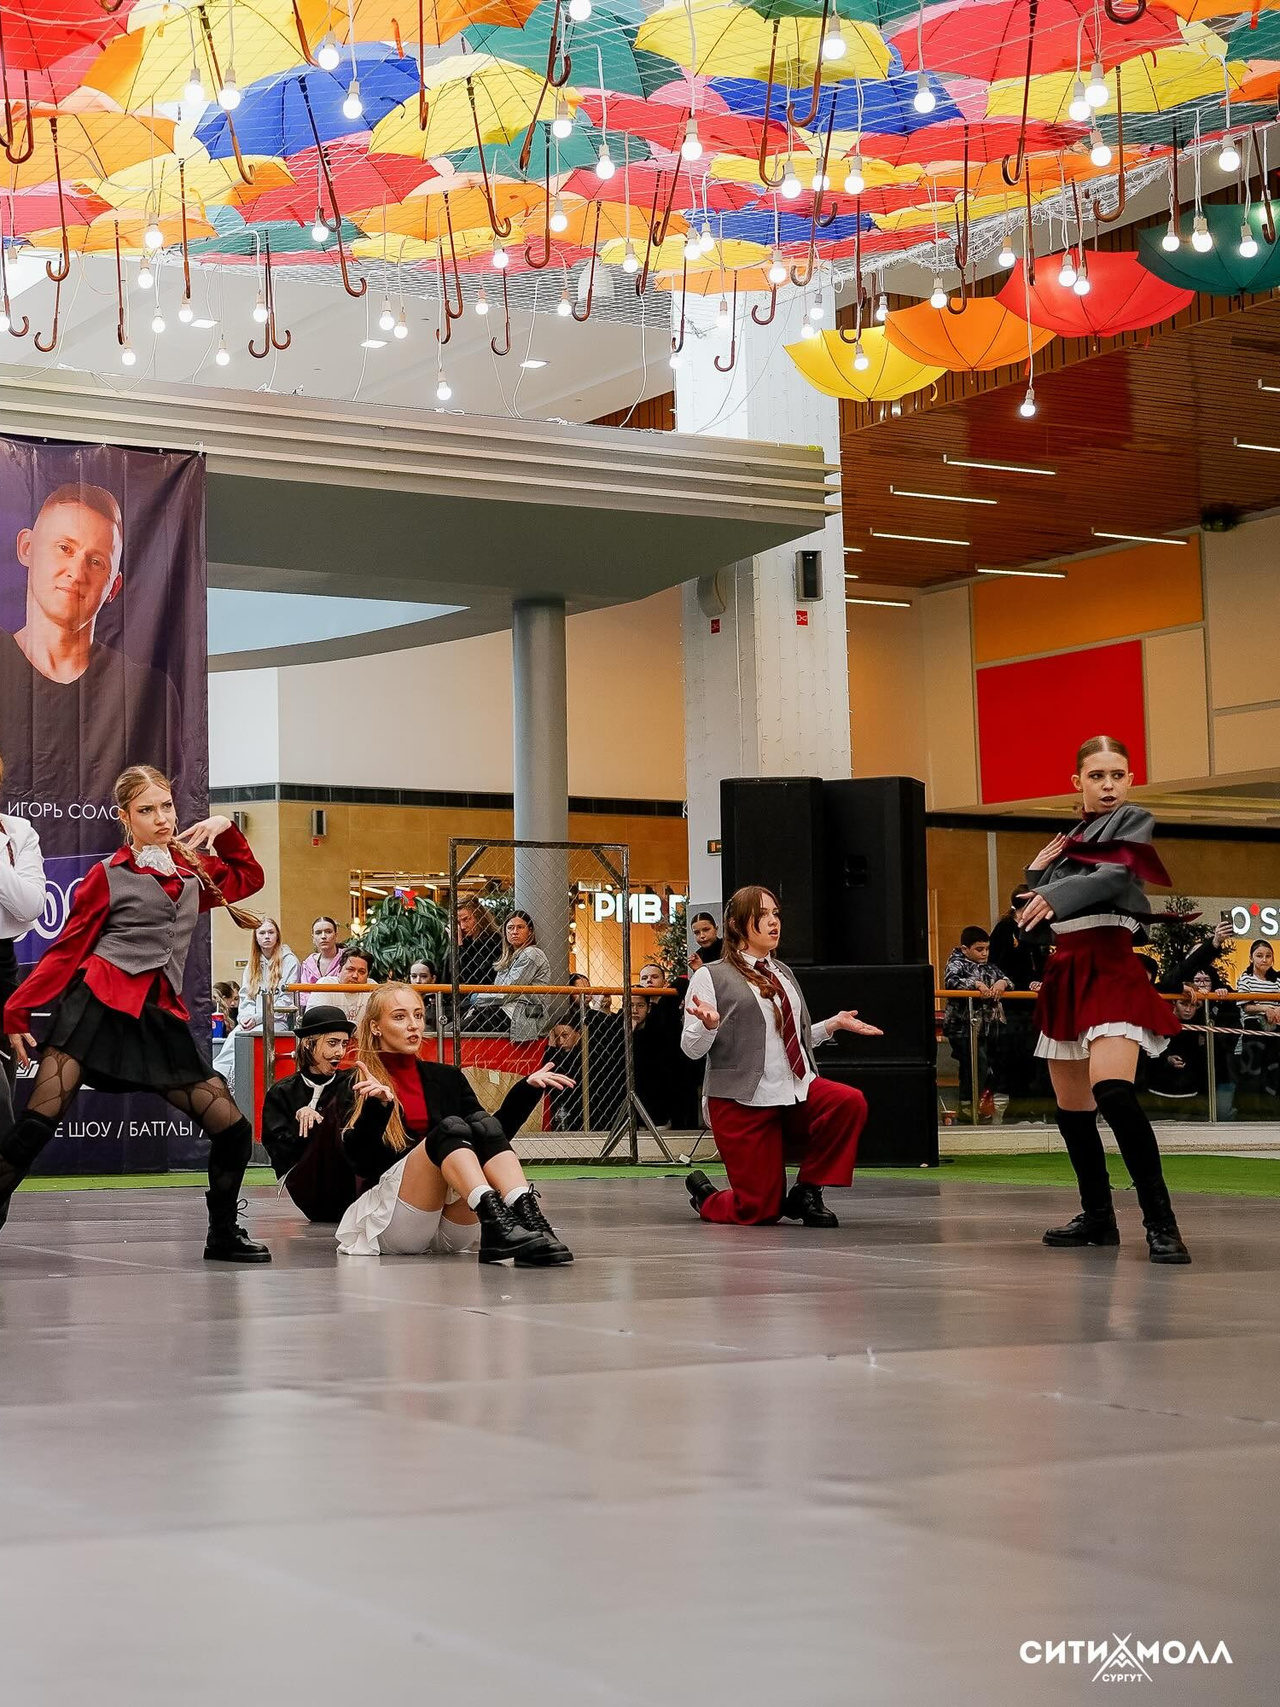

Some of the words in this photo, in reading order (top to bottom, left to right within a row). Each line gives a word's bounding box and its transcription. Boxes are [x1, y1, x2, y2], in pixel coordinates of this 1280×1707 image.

[7, 801, 63, 818] ИГОРЬ
[68, 803, 120, 820] СОЛО
[595, 892, 662, 924] РИВ
[1231, 903, 1280, 936] O'S
[68, 1121, 112, 1138] ШОУ
[129, 1120, 193, 1137] БАТТЛЫ
